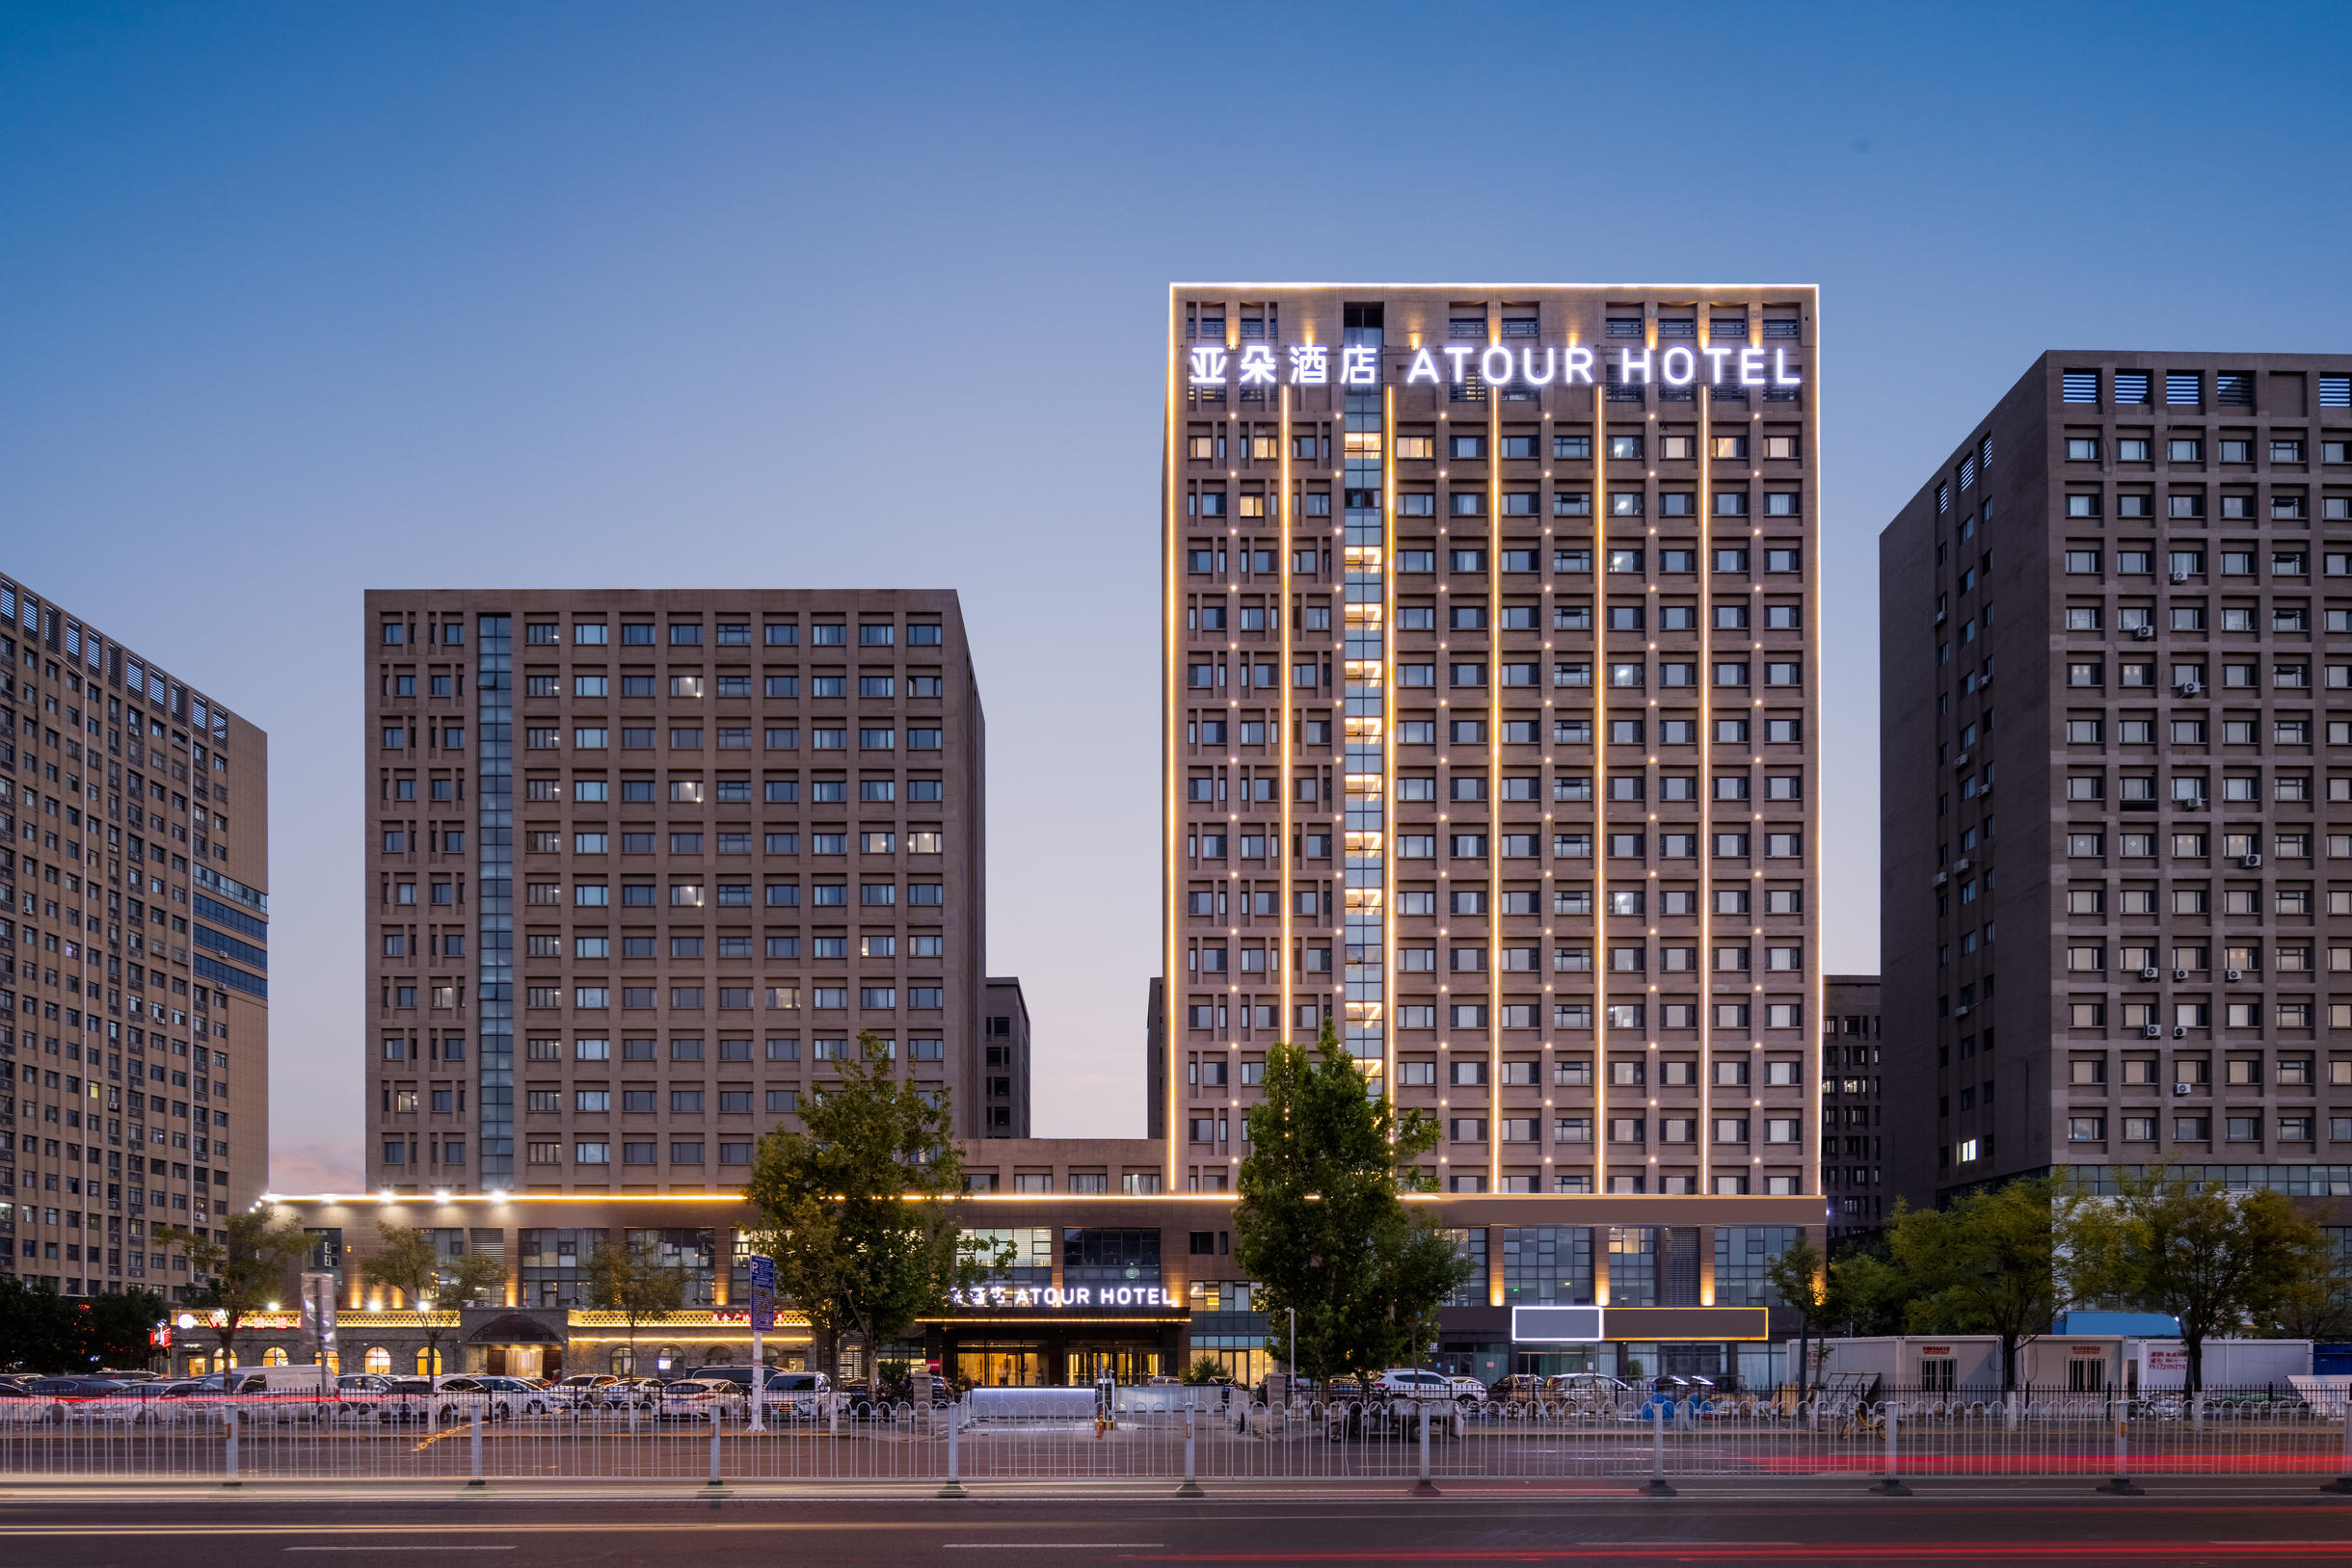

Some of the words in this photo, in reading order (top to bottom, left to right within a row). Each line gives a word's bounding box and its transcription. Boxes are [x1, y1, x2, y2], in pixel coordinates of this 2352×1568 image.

[1190, 344, 1376, 385] 亚朵酒店
[1407, 344, 1593, 385] ATOUR
[1622, 345, 1801, 385] HOTEL
[752, 1262, 759, 1272] P
[1014, 1287, 1090, 1305] ATOUR
[1101, 1287, 1173, 1305] HOTEL
